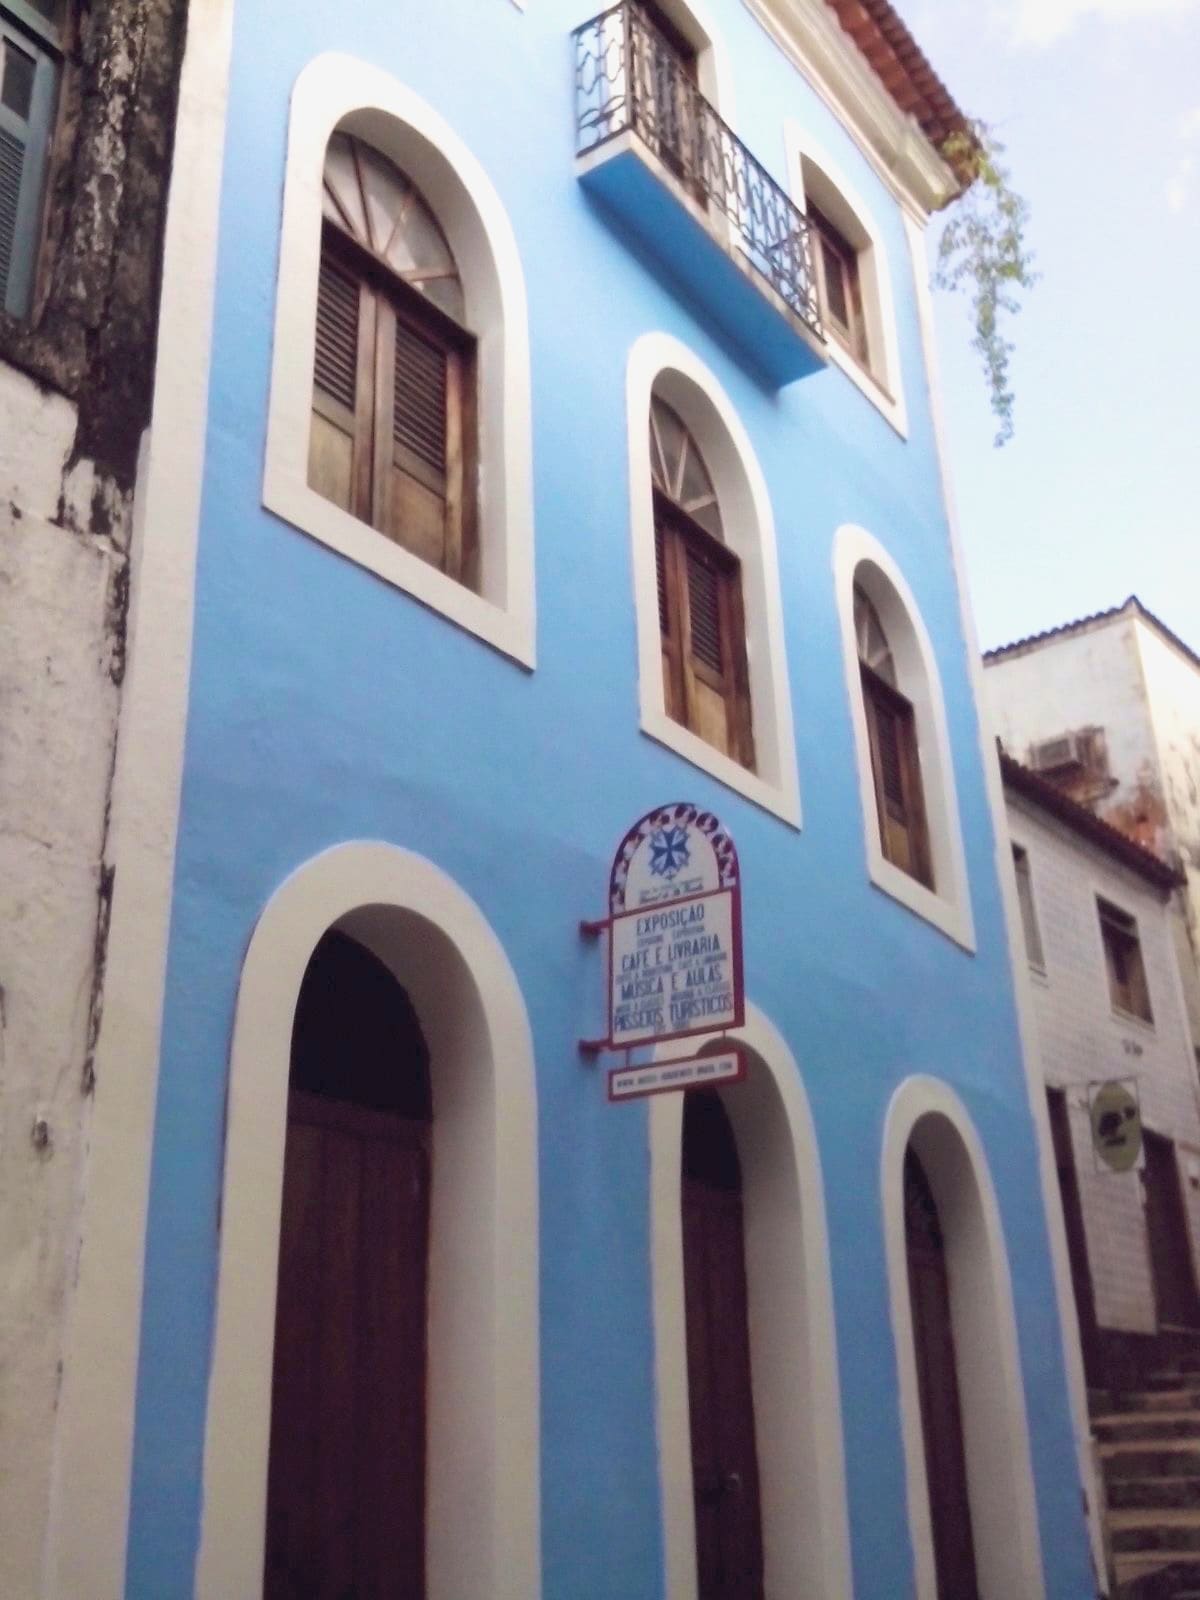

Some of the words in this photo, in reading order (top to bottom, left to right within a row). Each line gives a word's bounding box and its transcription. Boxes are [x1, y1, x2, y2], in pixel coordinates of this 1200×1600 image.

[655, 946, 663, 965] E
[668, 934, 721, 962] LIVRARIA
[672, 972, 680, 991] E
[686, 963, 722, 987] AULAS
